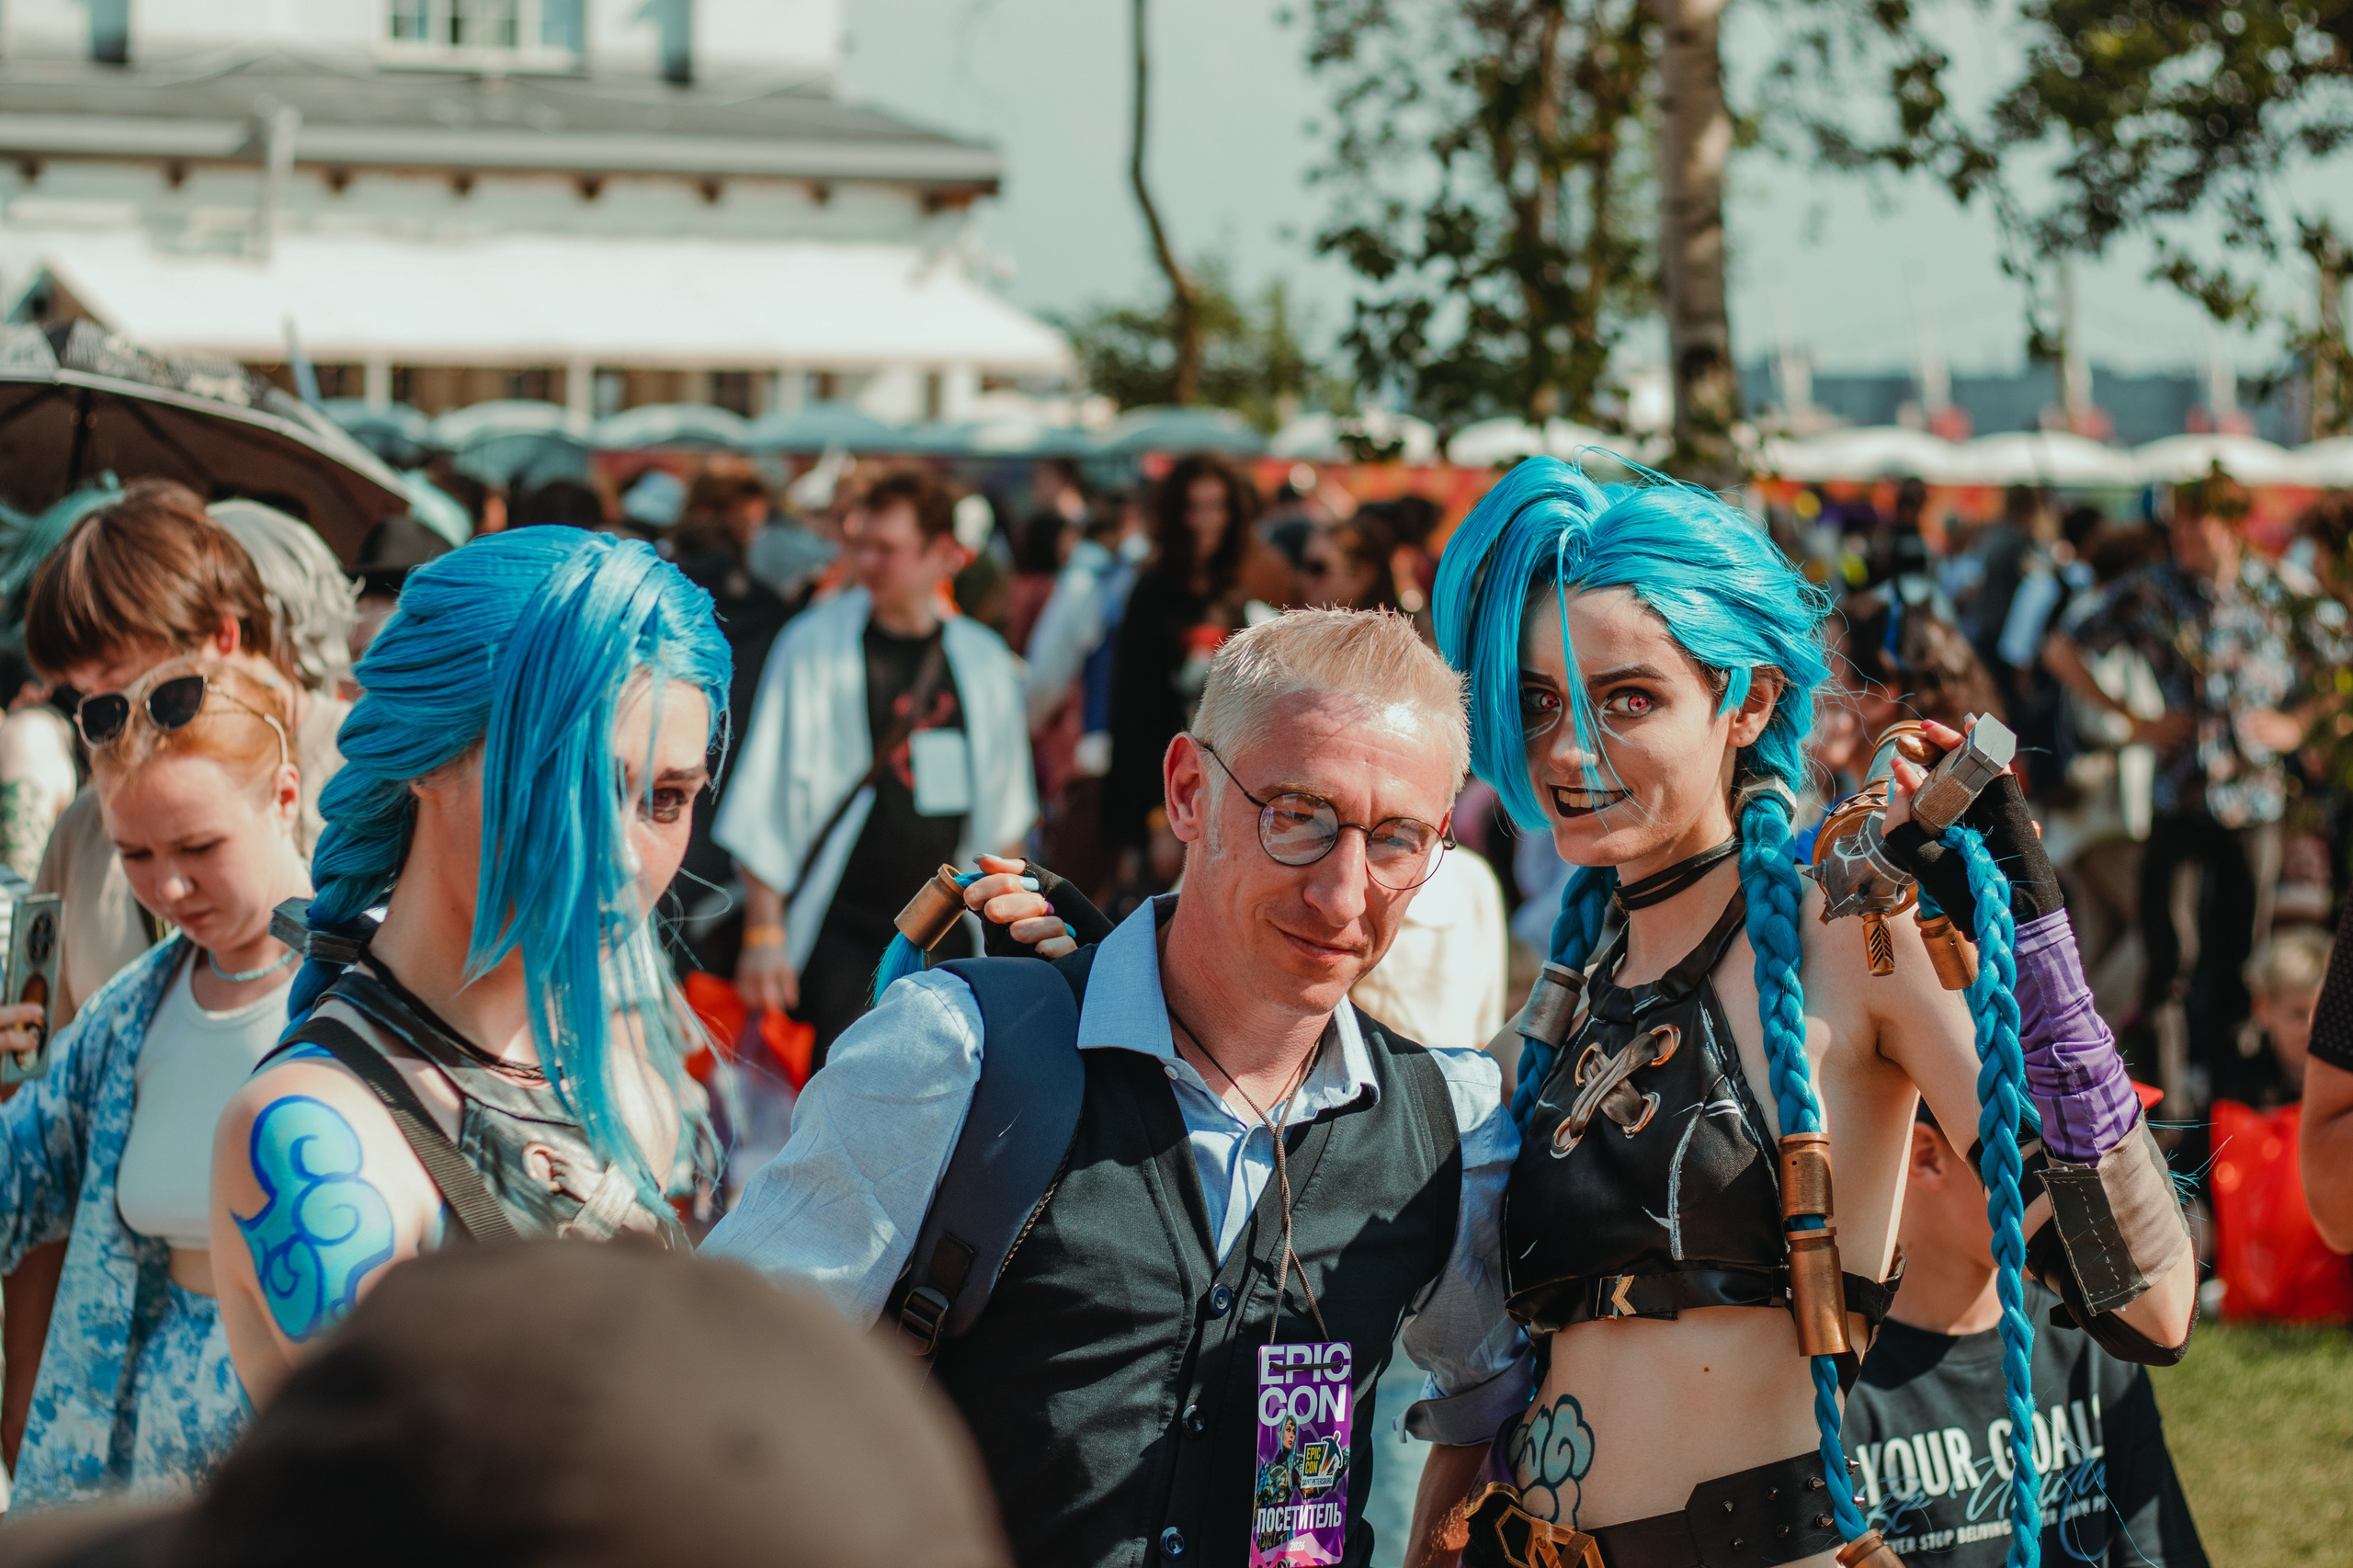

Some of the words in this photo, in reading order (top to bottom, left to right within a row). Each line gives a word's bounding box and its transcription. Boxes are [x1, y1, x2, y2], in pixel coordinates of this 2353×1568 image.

[1260, 1343, 1351, 1385] EPIC
[1259, 1384, 1347, 1426] CON
[1306, 1446, 1322, 1460] EPIC
[1855, 1426, 1982, 1507] YOUR
[1987, 1392, 2105, 1482] GOAL
[1304, 1460, 1319, 1475] CON
[1256, 1502, 1343, 1534] ПОСЕТИТЕЛЬ
[1289, 1540, 1306, 1551] 2026
[1919, 1528, 1955, 1551] STOP
